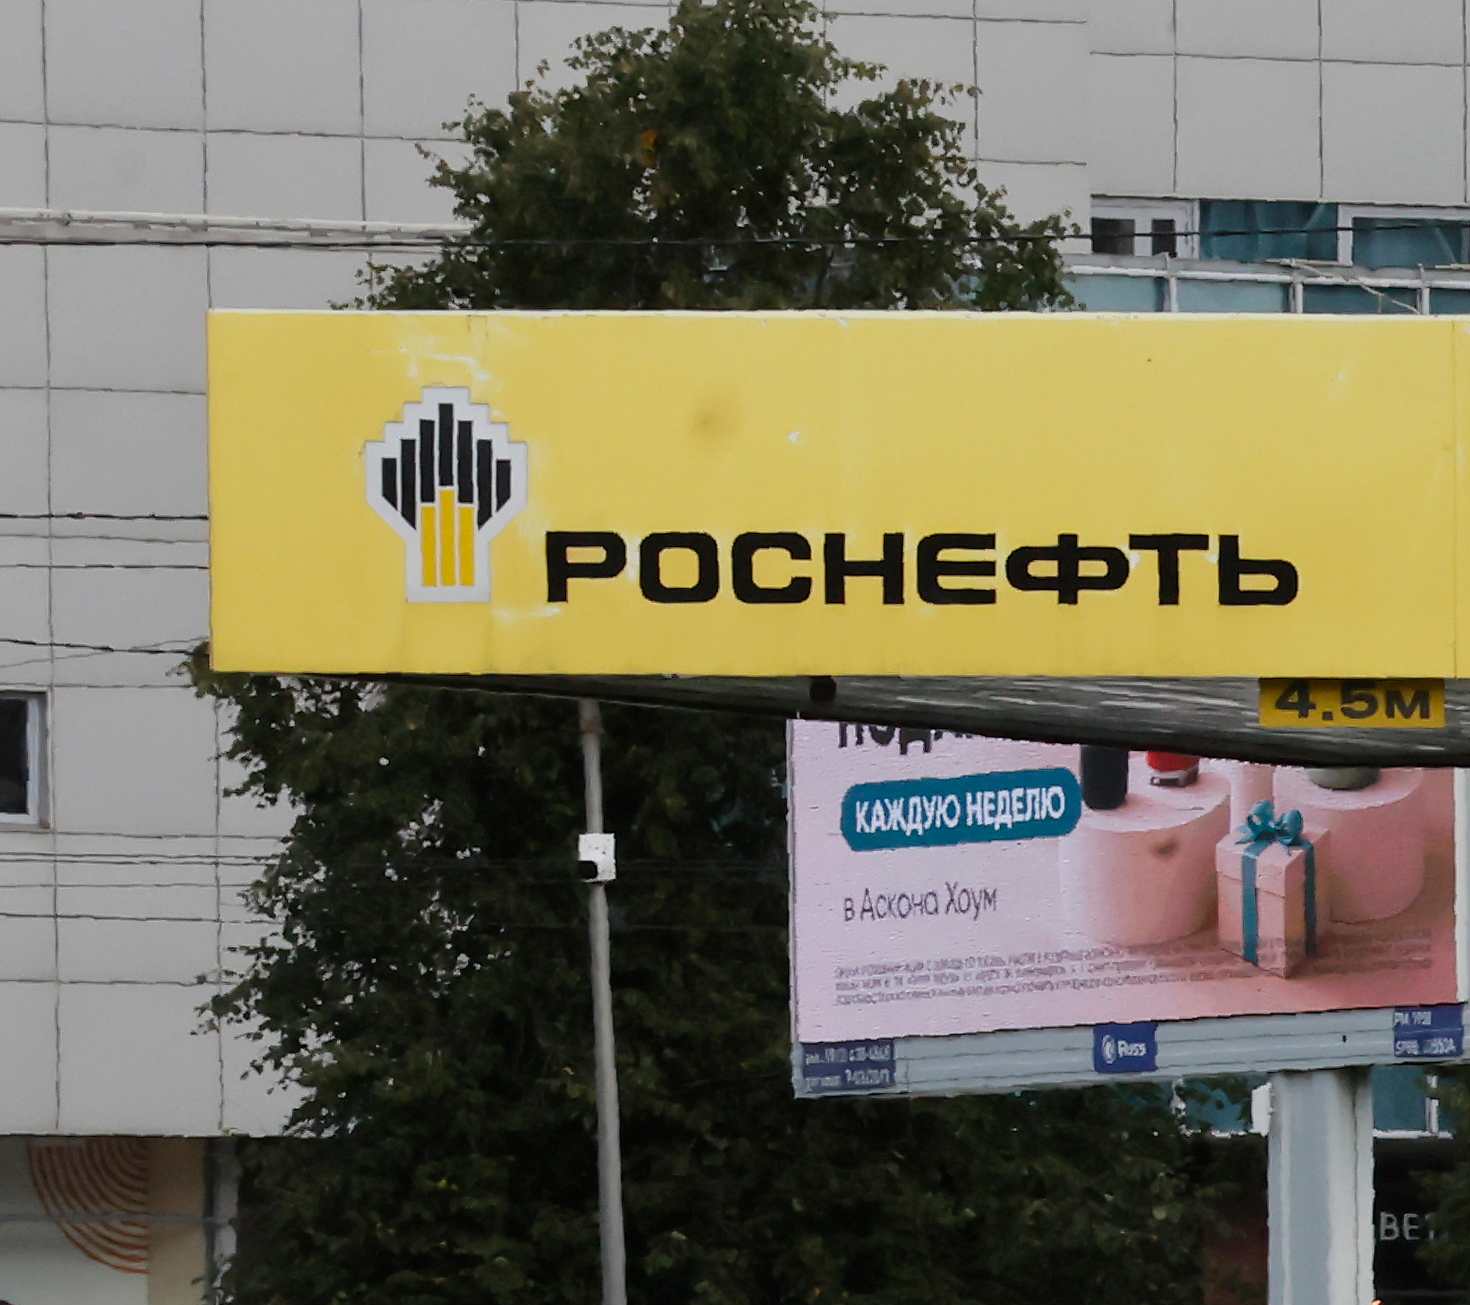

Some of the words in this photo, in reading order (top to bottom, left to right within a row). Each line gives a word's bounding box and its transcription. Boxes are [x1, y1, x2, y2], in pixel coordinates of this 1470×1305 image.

[545, 530, 1299, 606] РОСНЕФТЬ
[855, 794, 961, 836] КАЖДУЮ
[965, 785, 1066, 831] НЕДЕЛЮ
[843, 897, 856, 922] в
[860, 887, 940, 922] Аскона
[944, 881, 998, 921] Хоум
